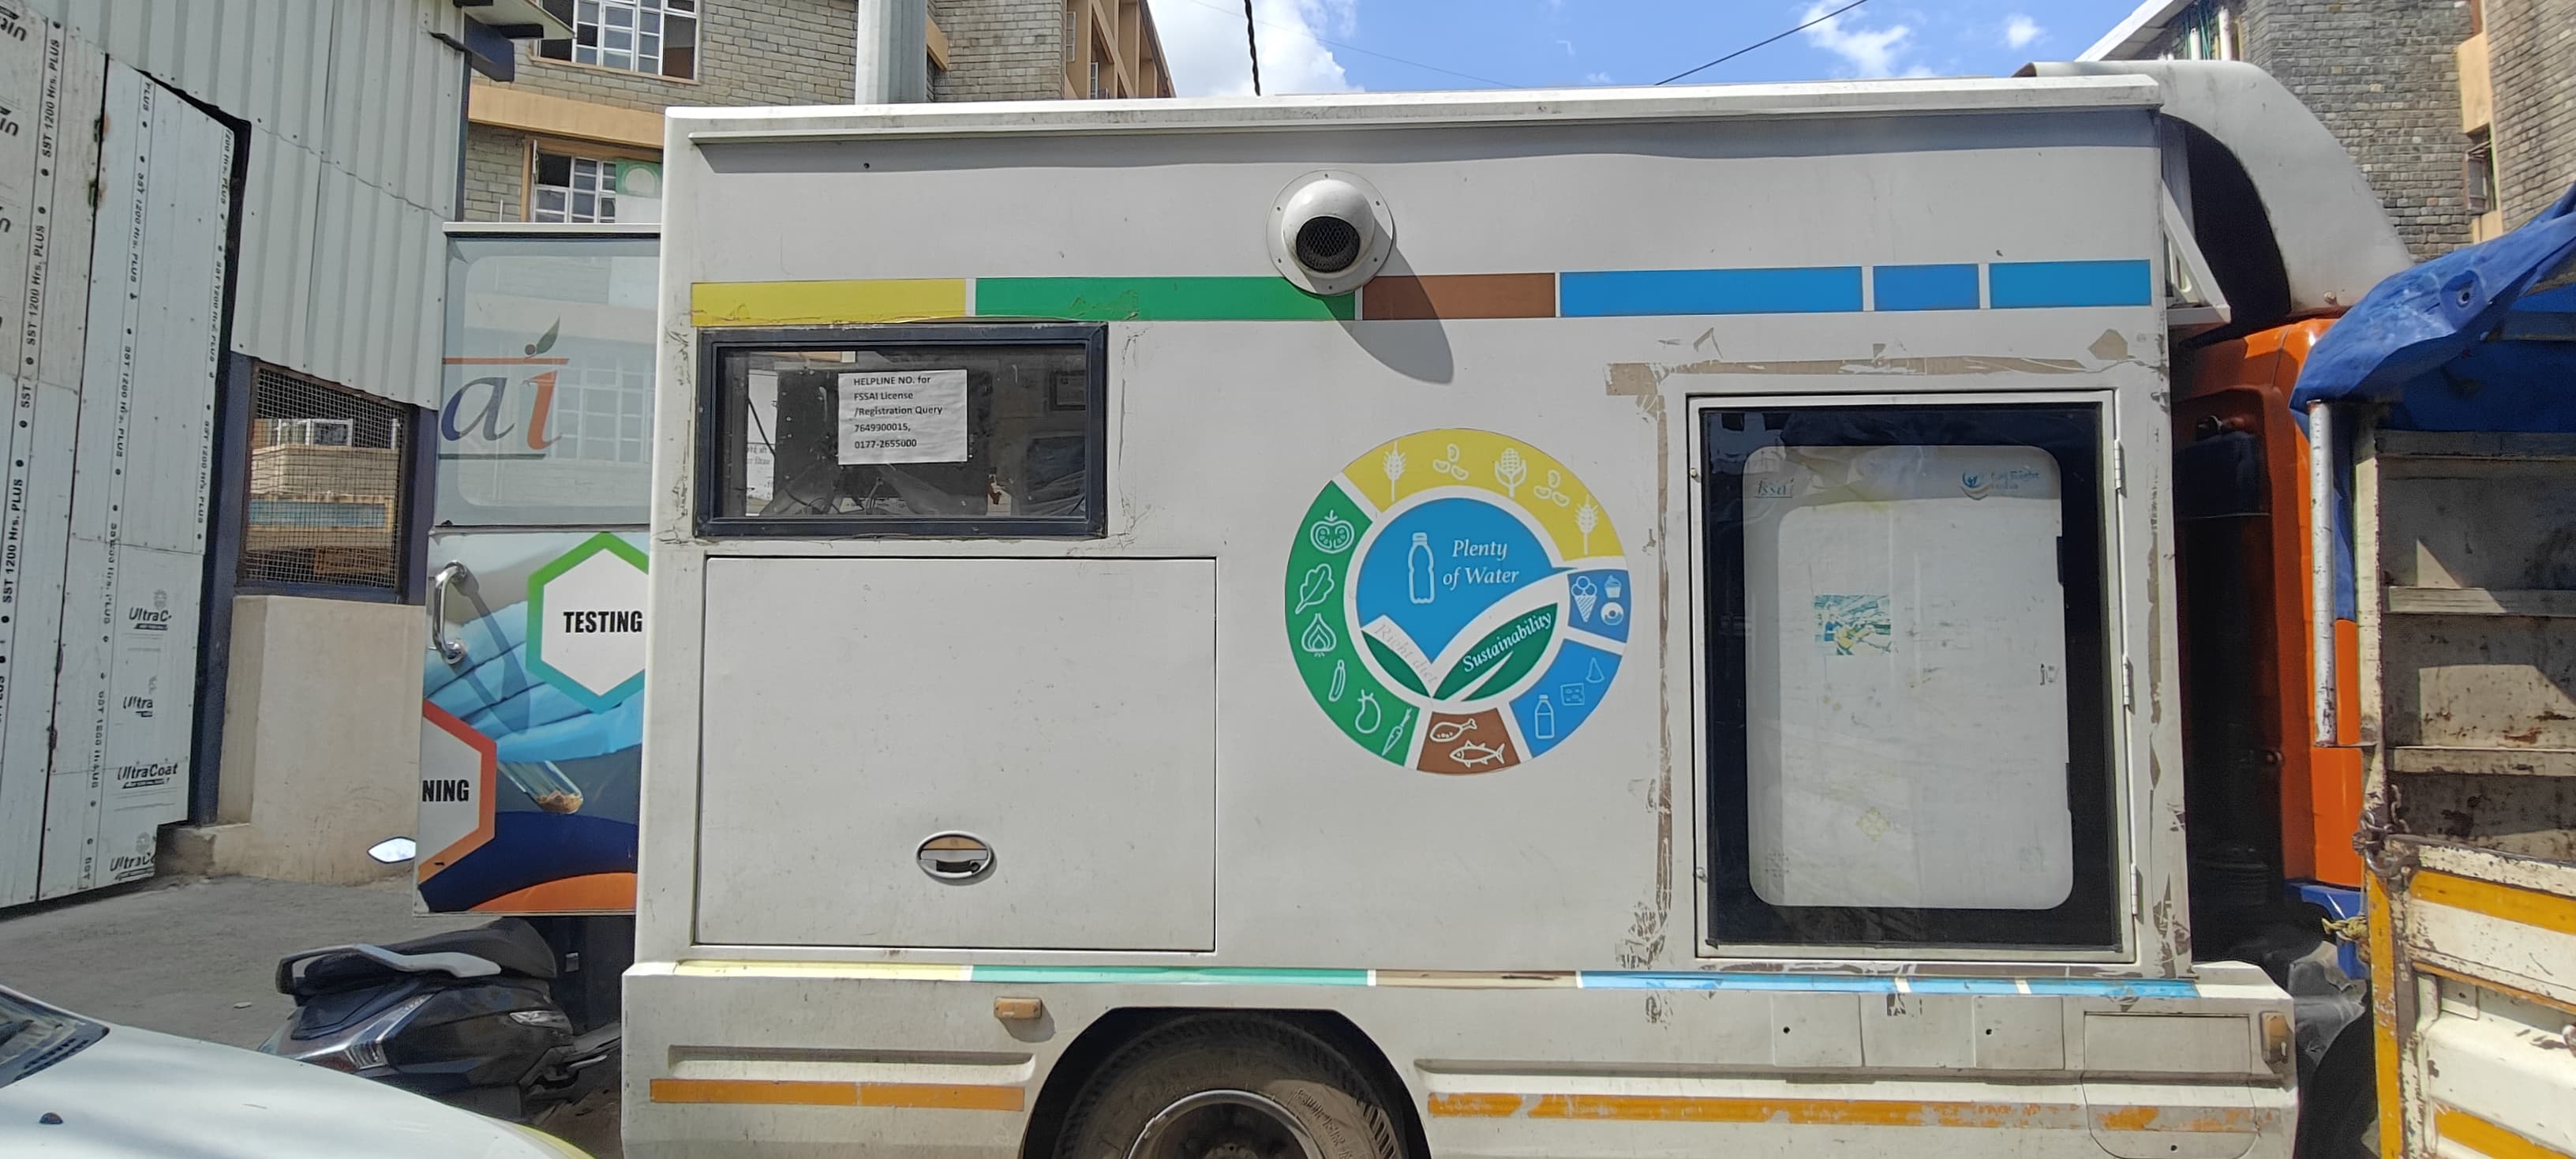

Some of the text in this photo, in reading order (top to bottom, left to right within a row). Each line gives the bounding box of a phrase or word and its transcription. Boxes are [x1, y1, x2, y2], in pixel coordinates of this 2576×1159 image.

[49, 39, 60, 71] PLUS
[47, 74, 57, 99] Hrs.
[44, 101, 55, 129] 1200
[134, 199, 143, 225] 1200
[27, 225, 45, 346] SST 1200 Hrs. PLUS
[853, 375, 931, 386] HELPLINE NO. for
[21, 384, 32, 408] SST
[854, 392, 914, 401] FSSAI License
[854, 406, 942, 417] /Registration Query
[116, 428, 125, 457] PLUS
[855, 439, 917, 449] 0177-2655000
[2, 478, 23, 604] SST 1200 Hrs. PLUS
[1452, 538, 1508, 561] Plenty
[1443, 566, 1519, 591] of Water
[563, 610, 643, 633] TESTING
[1462, 612, 1552, 673] Sustainability
[118, 763, 178, 780] UltraCoat
[421, 779, 470, 802] NING
